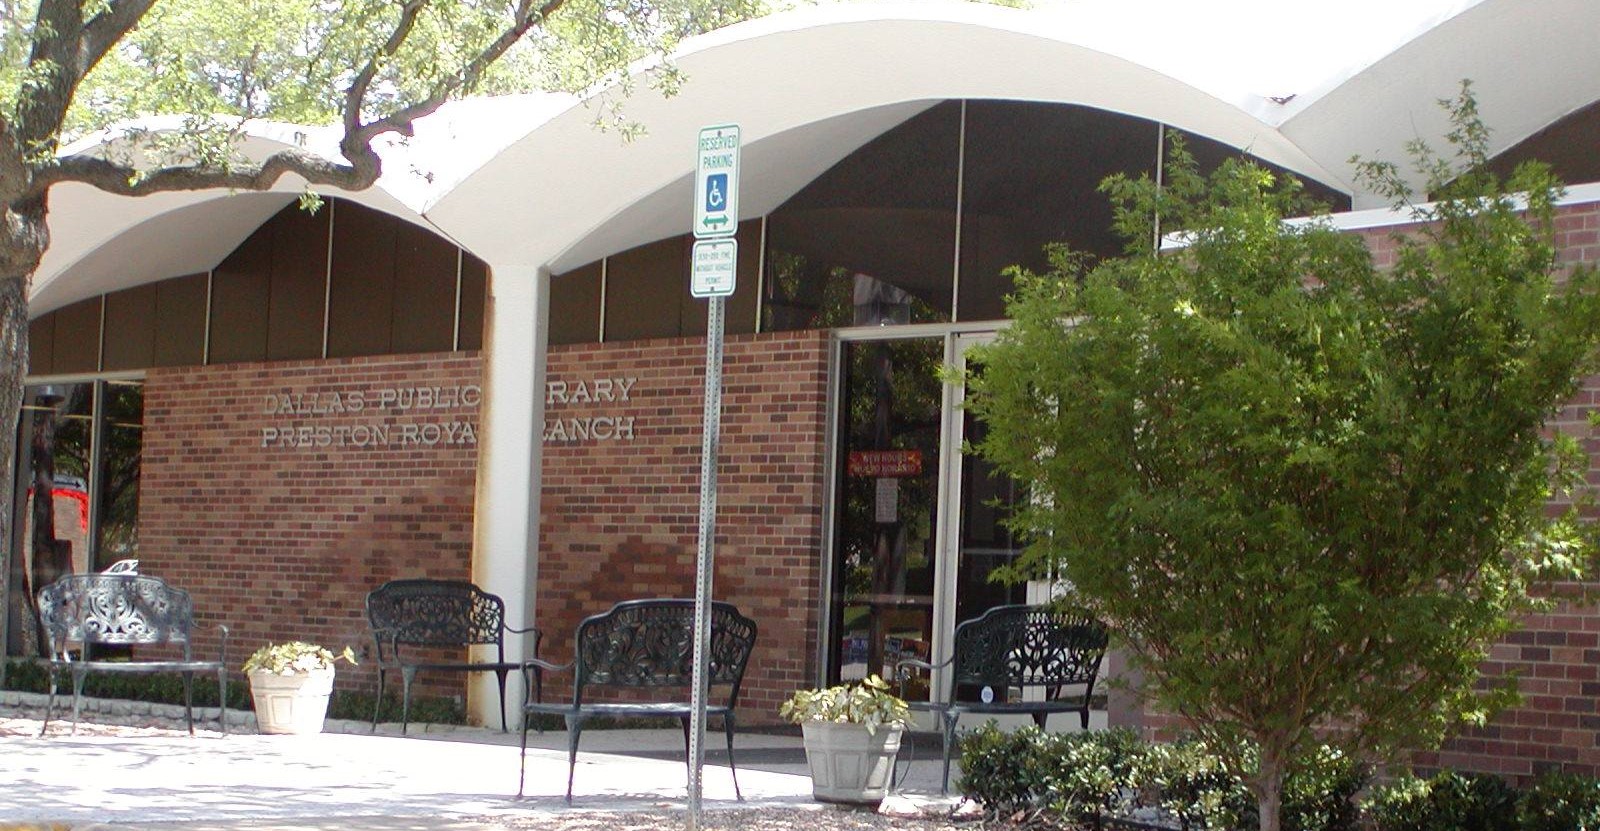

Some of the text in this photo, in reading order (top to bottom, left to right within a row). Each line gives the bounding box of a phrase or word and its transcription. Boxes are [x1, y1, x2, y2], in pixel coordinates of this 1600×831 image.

[700, 135, 736, 150] RESERVED
[704, 153, 733, 168] PARKING
[262, 378, 638, 414] DALLAS PUBLIC RARY
[261, 416, 637, 448] PRESTON ROYA ANCH
